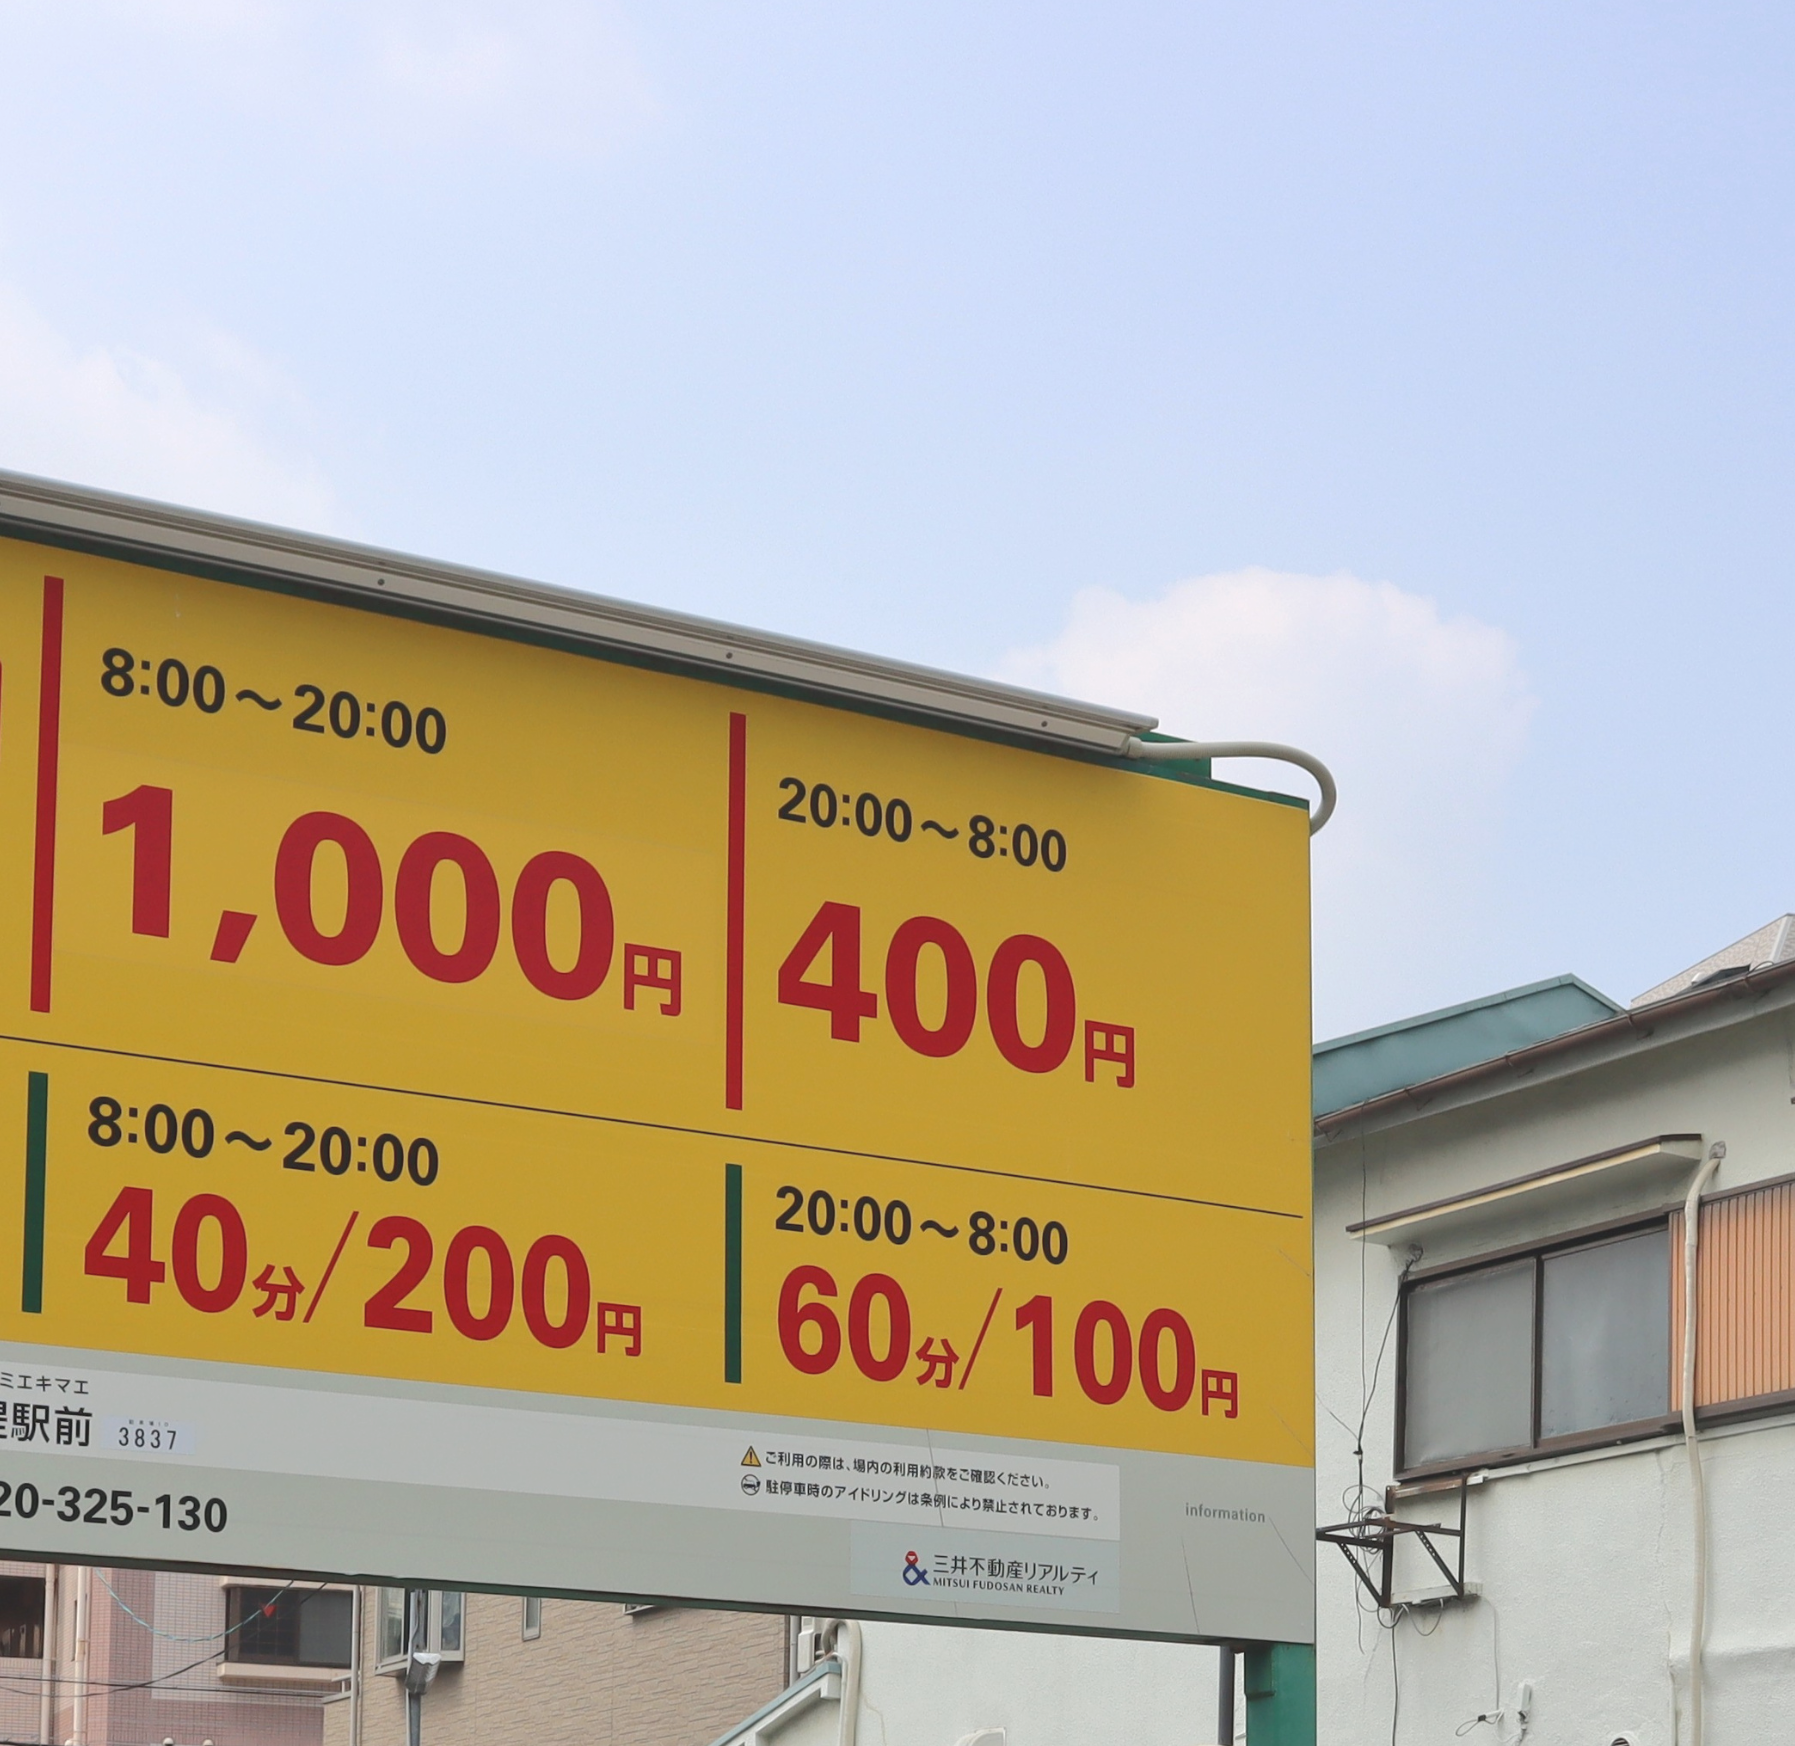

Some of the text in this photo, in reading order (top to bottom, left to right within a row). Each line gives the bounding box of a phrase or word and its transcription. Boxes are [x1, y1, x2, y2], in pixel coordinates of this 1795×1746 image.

[102, 784, 682, 1016] 1,000円
[777, 901, 1134, 1088] 400円
[118, 1427, 176, 1450] 3837
[766, 1452, 1050, 1488] ご利用の際は、場内の利用約款をご確認ください。
[766, 1480, 1099, 1521] 駐停車時のアイドリングは条例により禁止されております。
[1185, 1502, 1266, 1524] information
[933, 1554, 1099, 1585] 三井不動産リアルティ
[933, 1578, 1065, 1596] MITSUI FUDOSAN REALTY
